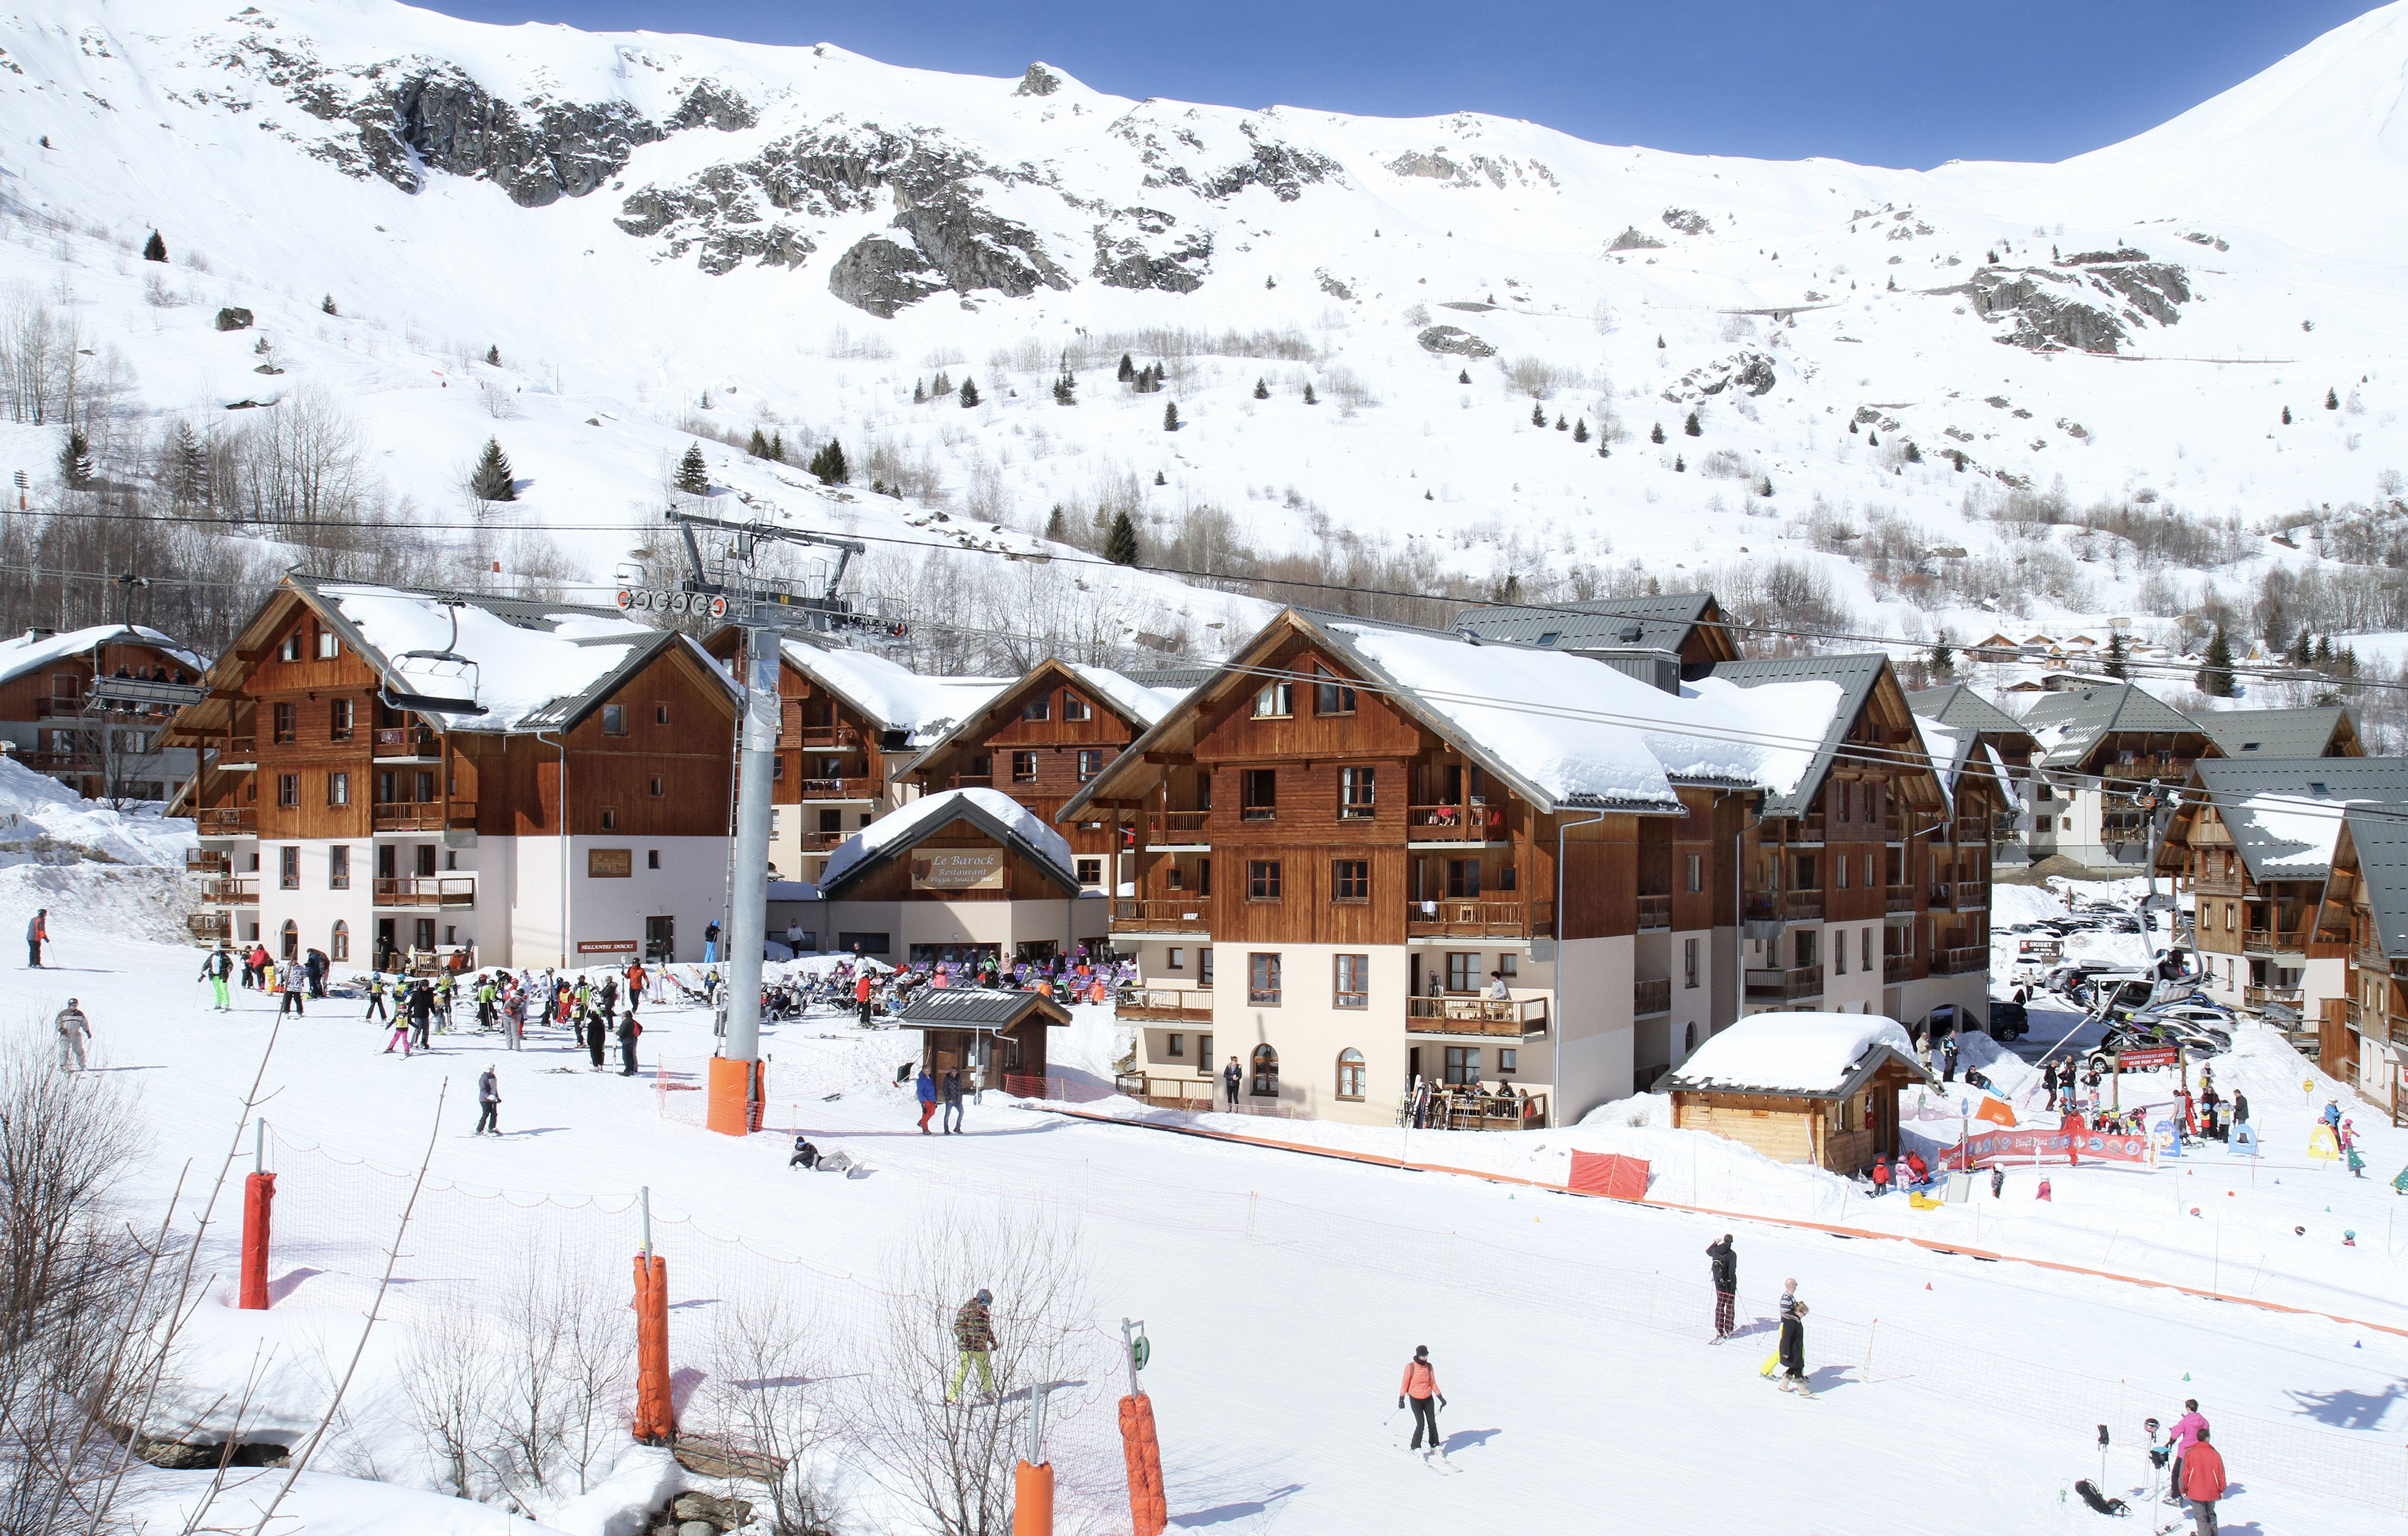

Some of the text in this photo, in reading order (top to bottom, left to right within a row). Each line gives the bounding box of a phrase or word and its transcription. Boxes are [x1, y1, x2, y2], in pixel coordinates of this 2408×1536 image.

[932, 854, 994, 865] Le Barock
[2015, 1137, 2048, 1148] Piou Piou
